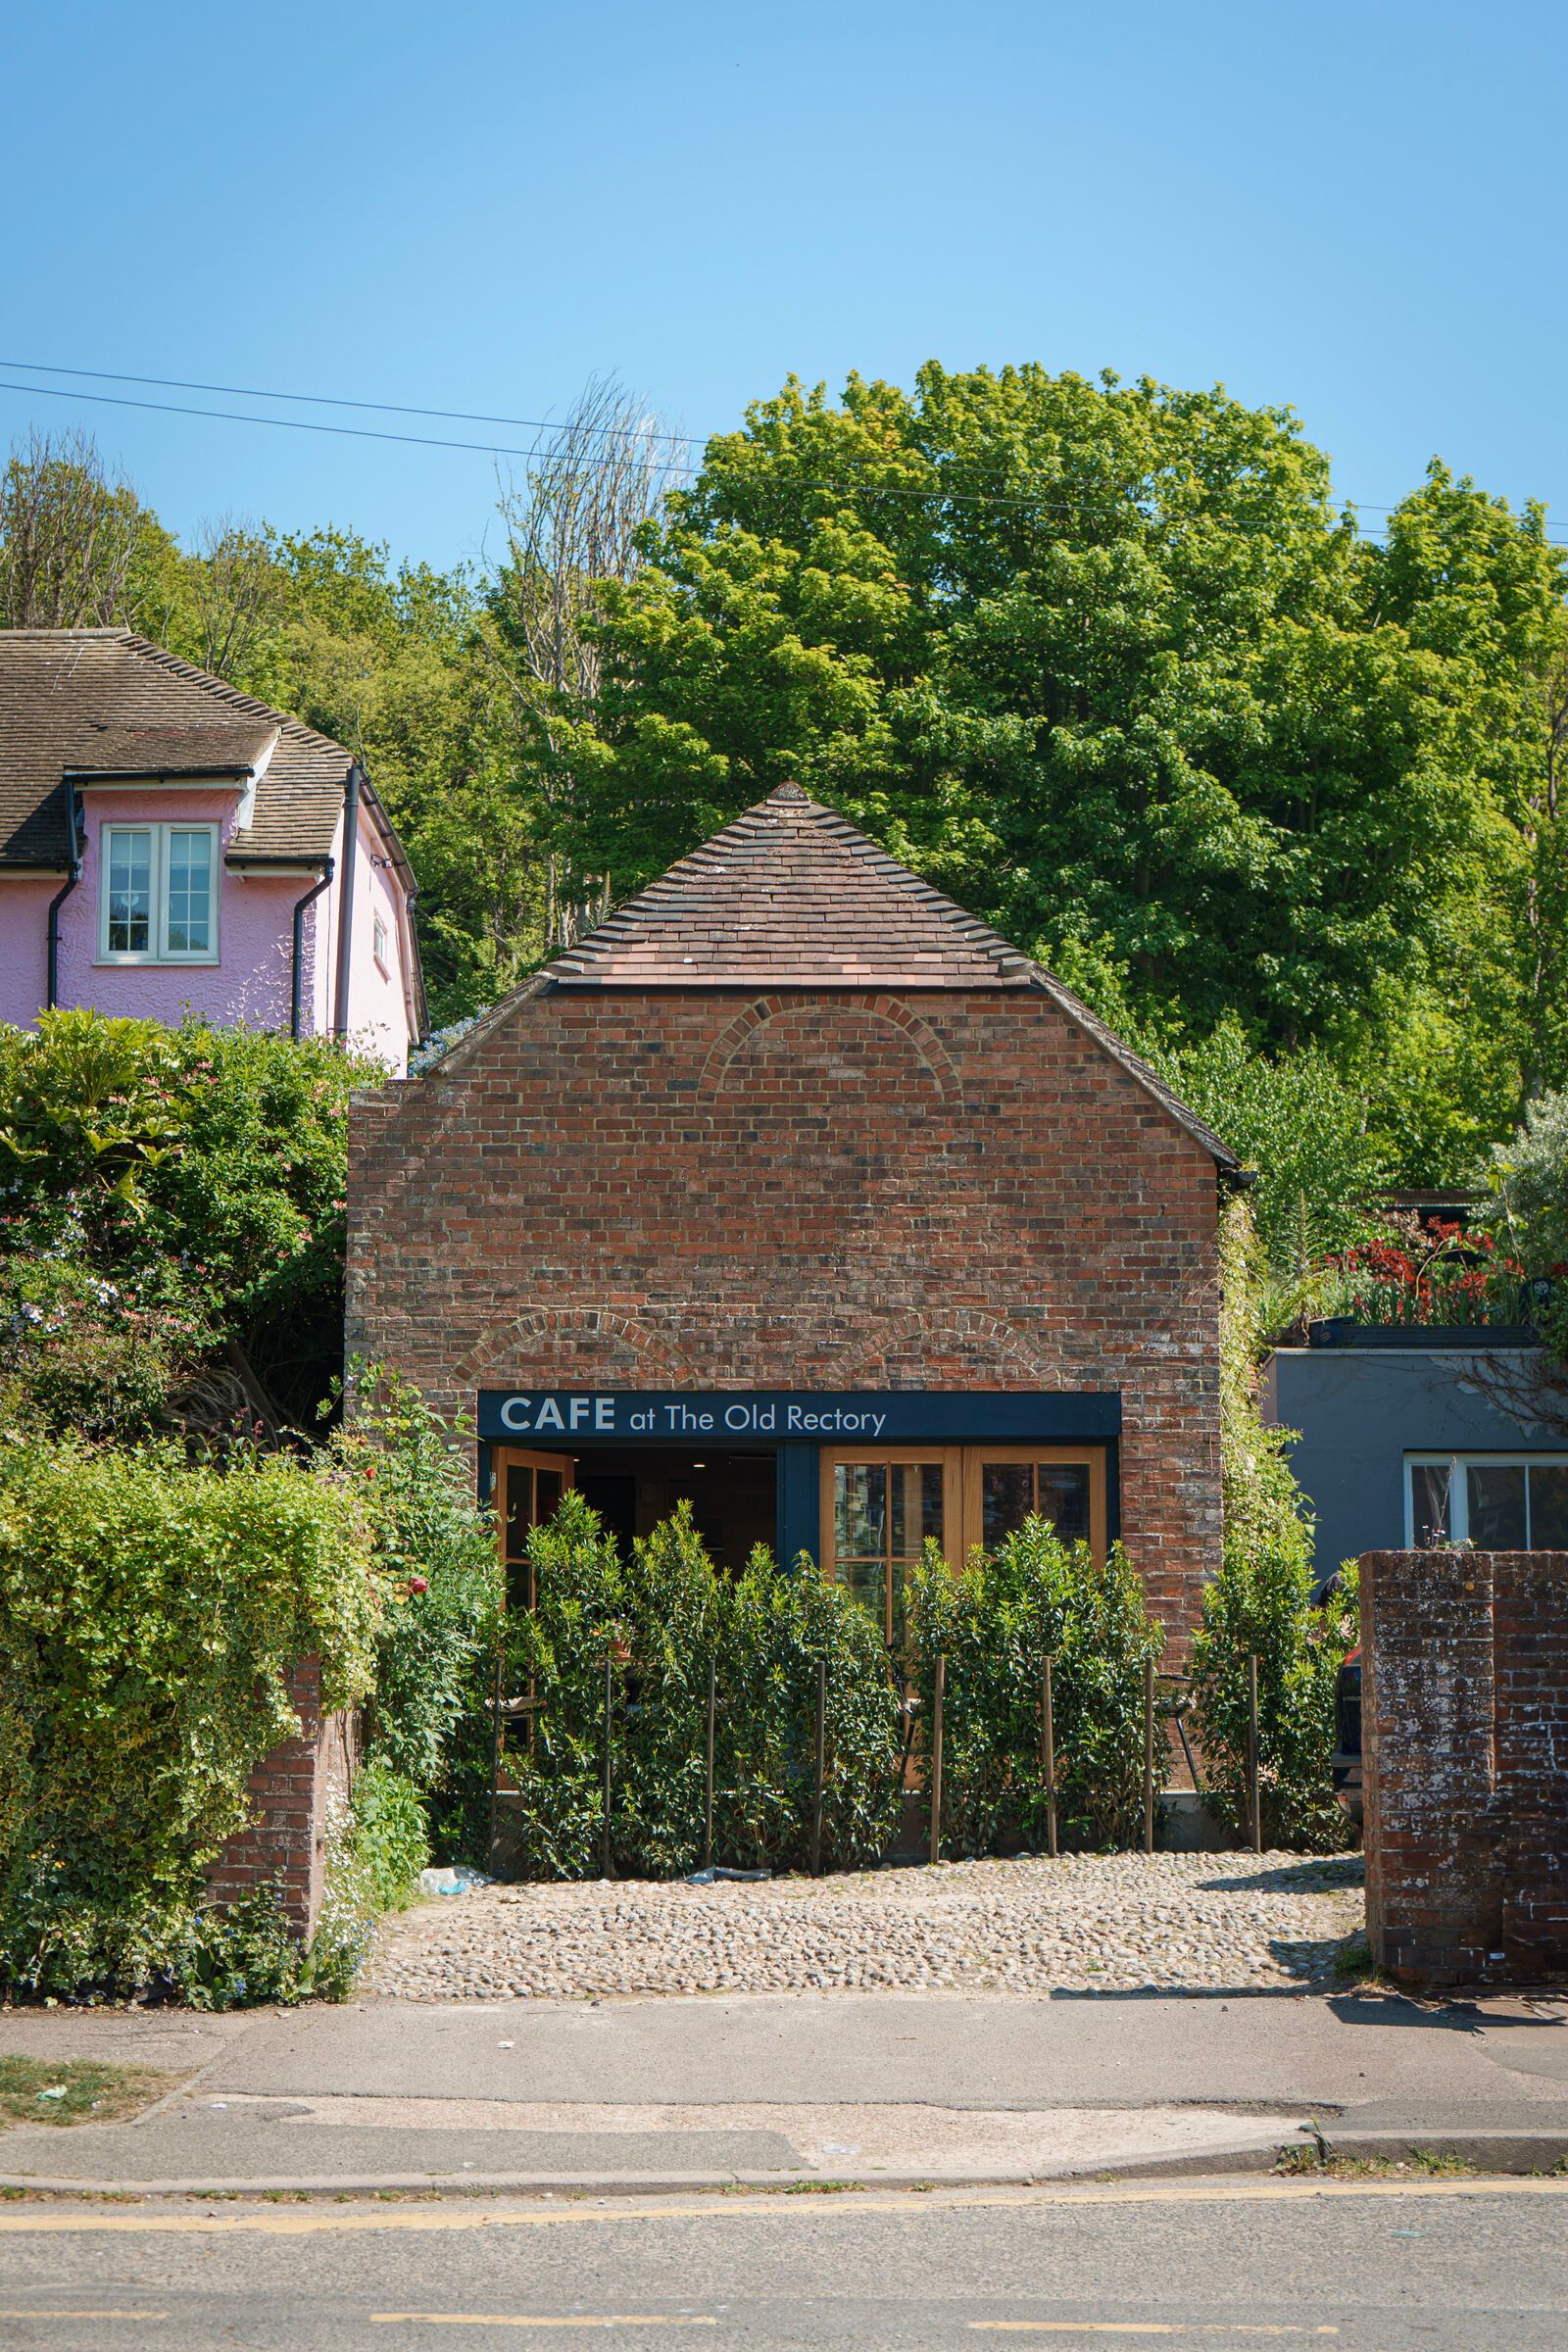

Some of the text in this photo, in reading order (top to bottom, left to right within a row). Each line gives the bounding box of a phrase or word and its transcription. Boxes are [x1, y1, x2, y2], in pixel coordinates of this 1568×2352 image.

[501, 1396, 887, 1437] CAFE at The Old Rectory
